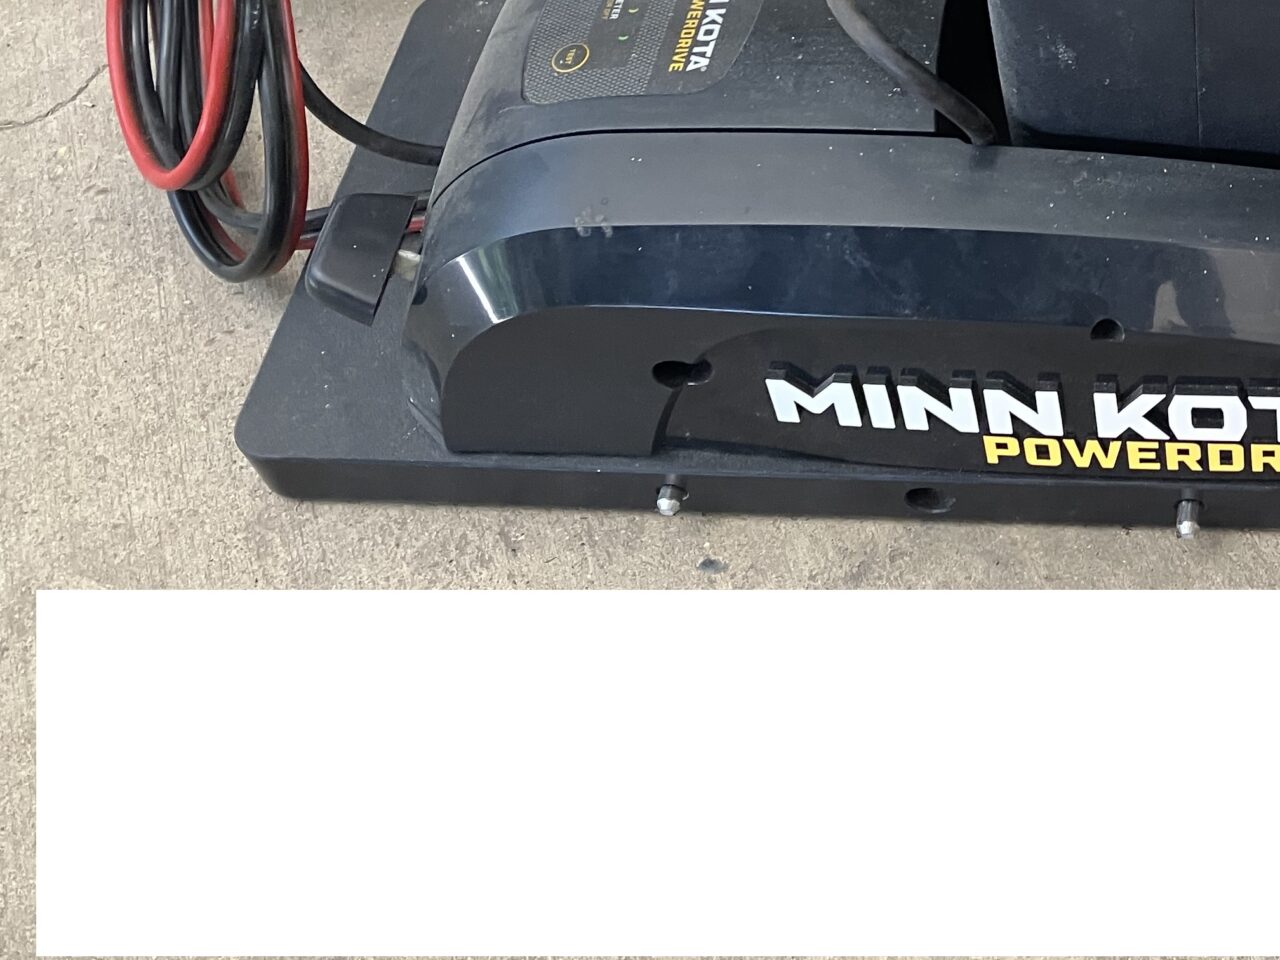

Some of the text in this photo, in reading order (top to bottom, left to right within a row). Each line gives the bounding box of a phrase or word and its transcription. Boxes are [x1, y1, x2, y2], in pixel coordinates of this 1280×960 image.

[564, 48, 577, 64] TEST
[686, 8, 727, 72] KOTA
[765, 377, 1063, 436] MINN
